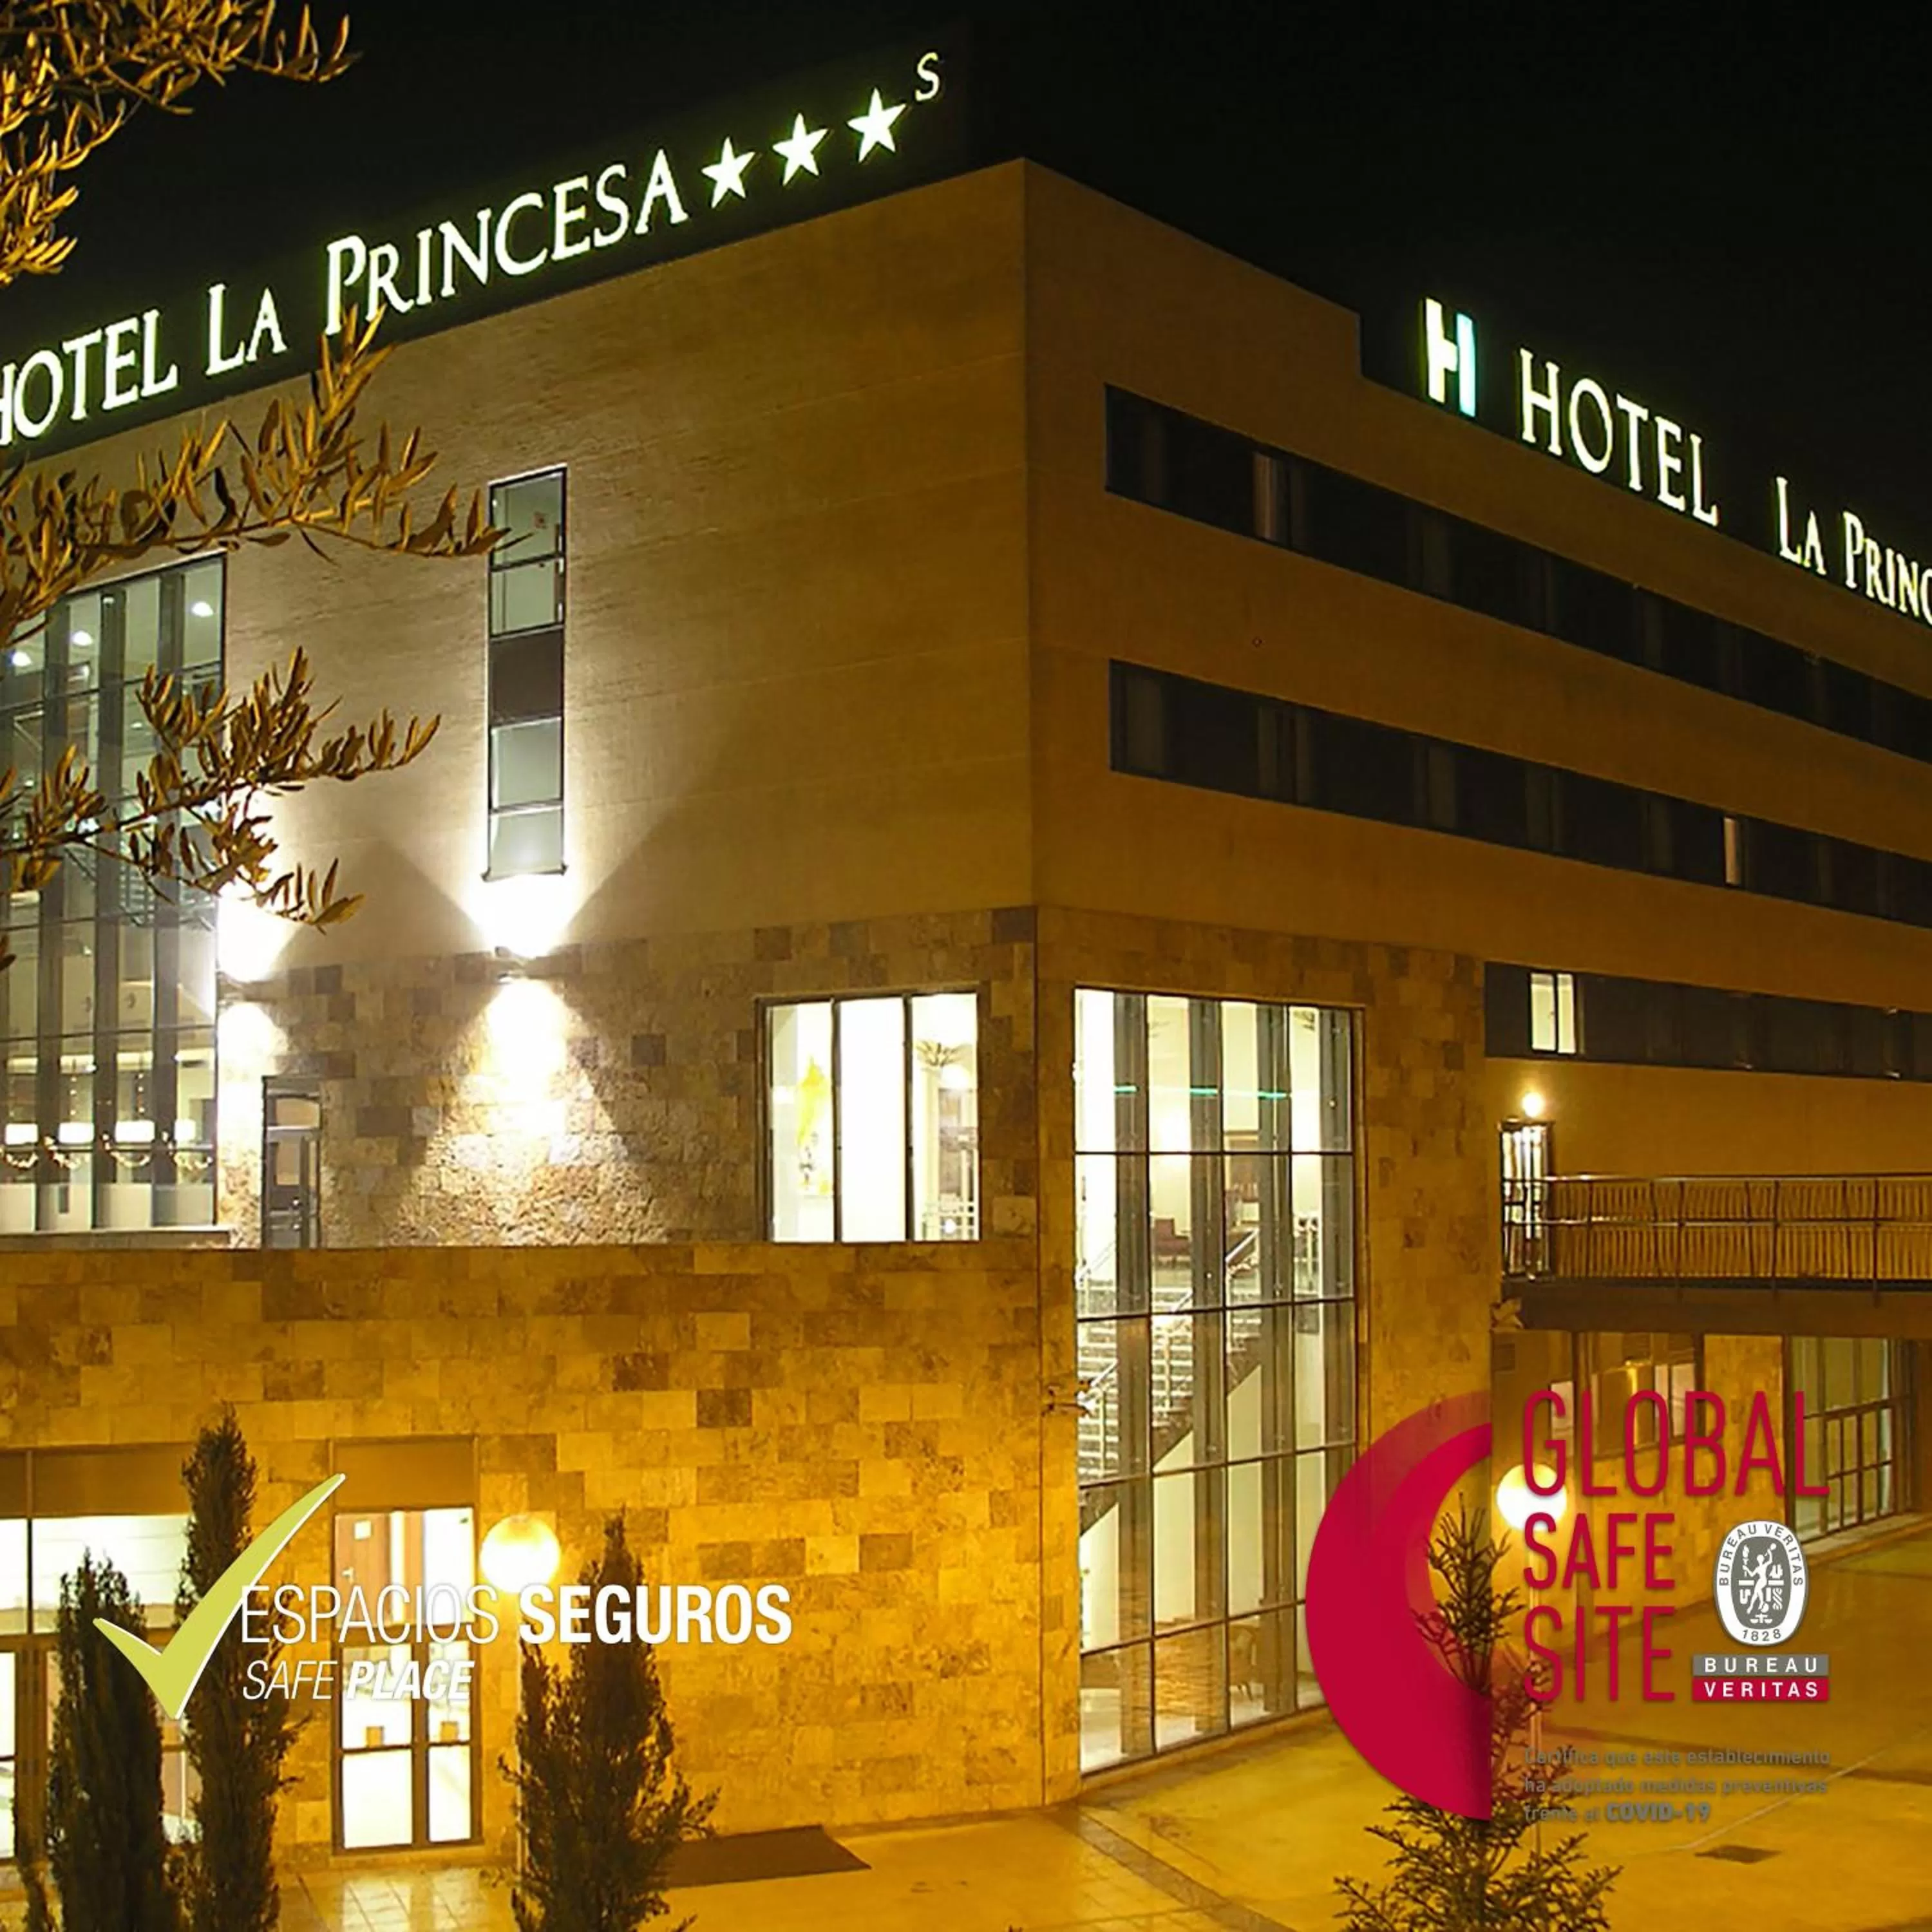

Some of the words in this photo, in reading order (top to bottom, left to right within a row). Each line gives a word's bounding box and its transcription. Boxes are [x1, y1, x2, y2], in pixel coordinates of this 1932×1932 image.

[205, 283, 288, 377] LA
[325, 149, 689, 336] PRINCESA
[1425, 298, 1476, 418] H
[1519, 348, 1719, 527] HOTEL
[1776, 476, 1827, 575] LA
